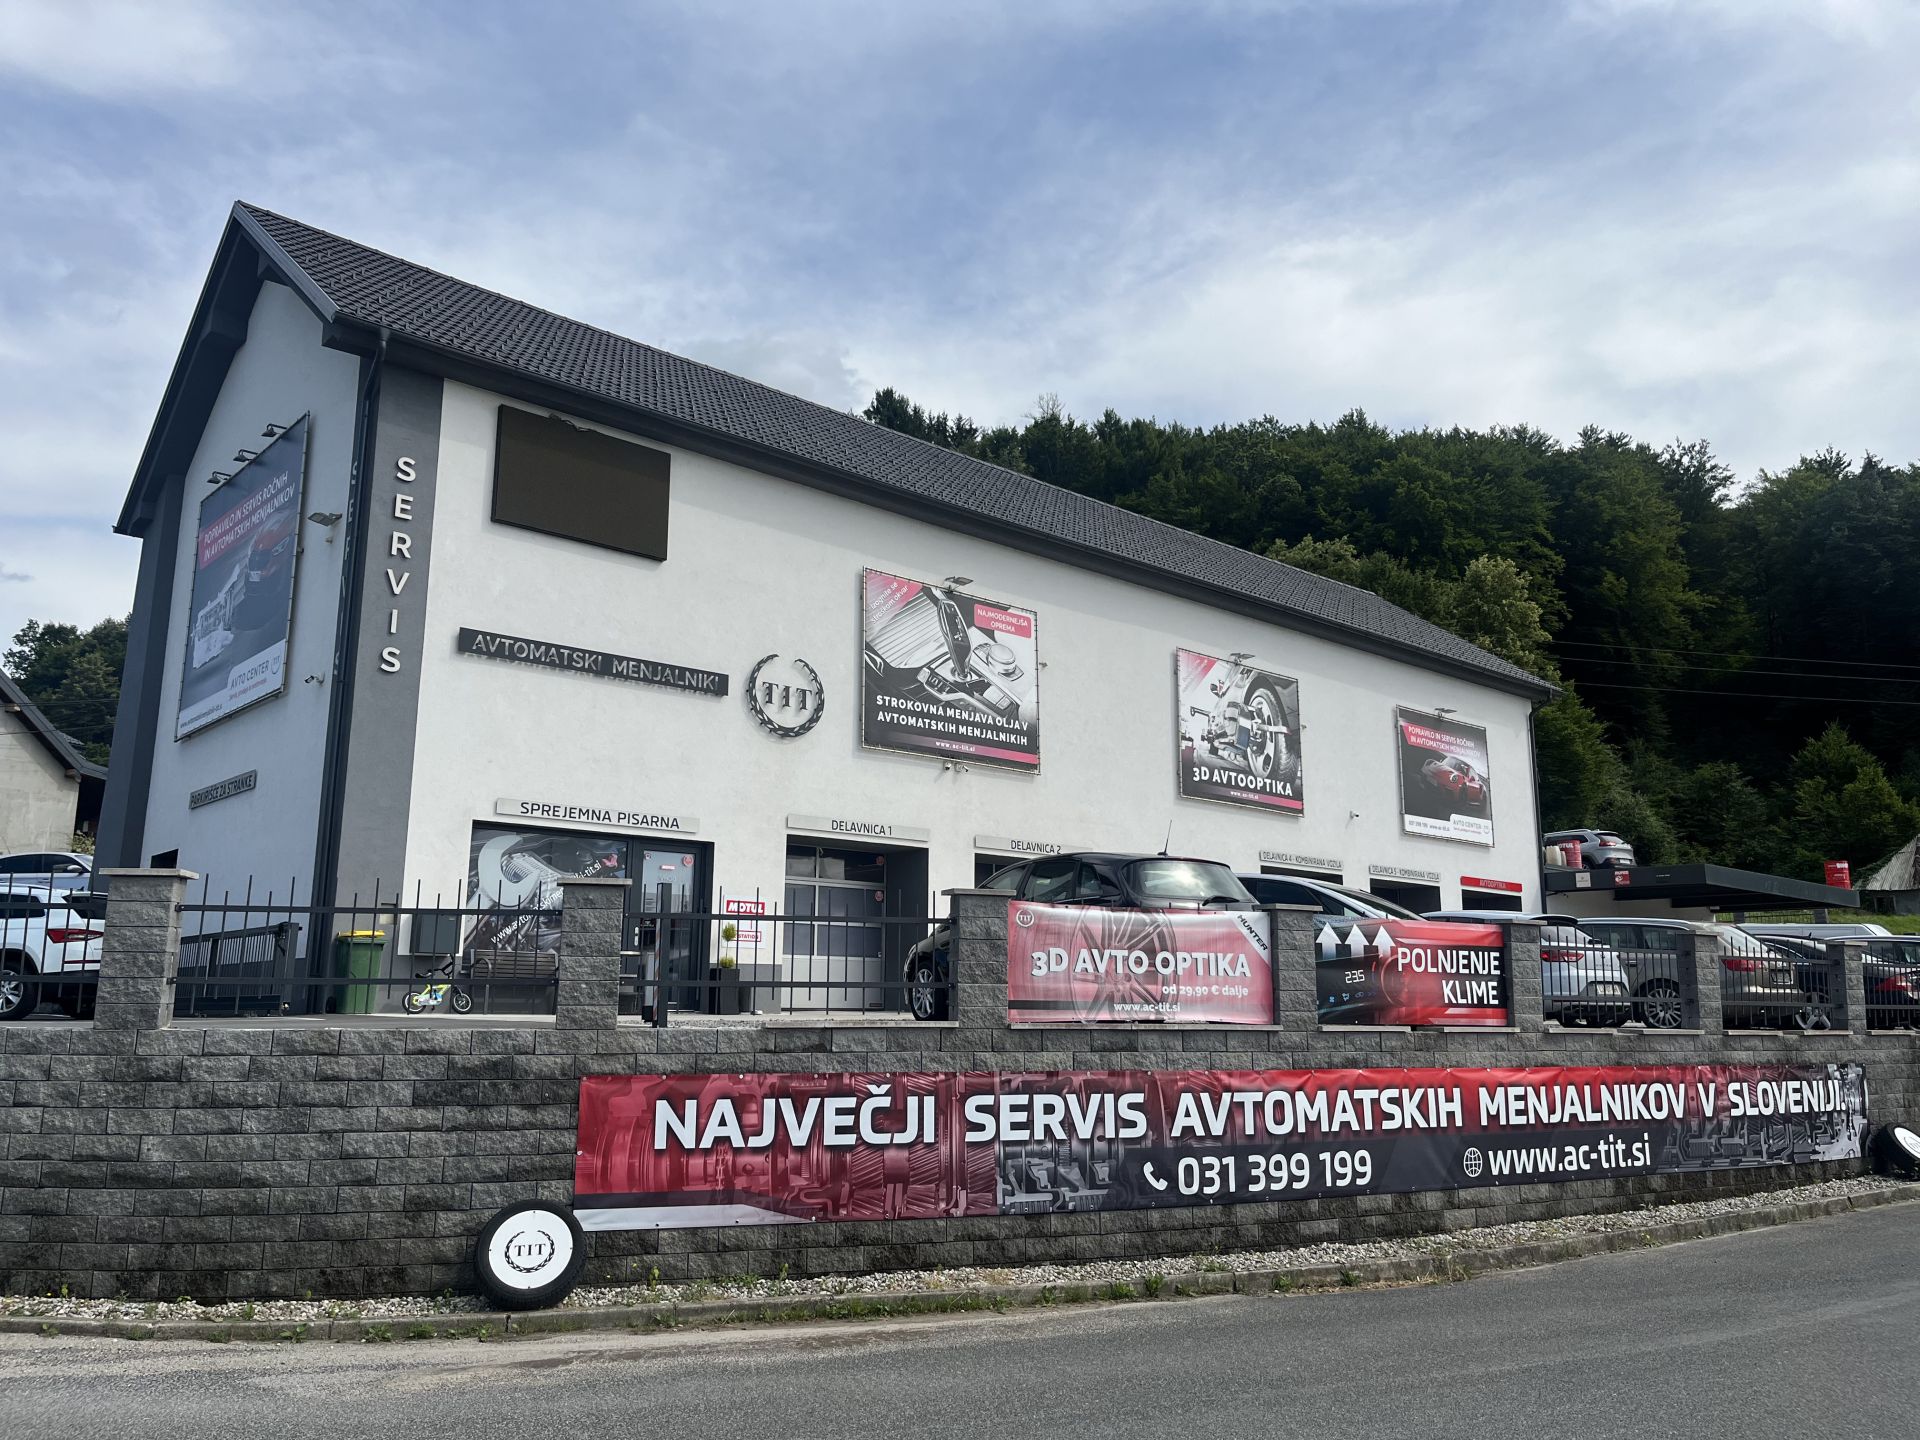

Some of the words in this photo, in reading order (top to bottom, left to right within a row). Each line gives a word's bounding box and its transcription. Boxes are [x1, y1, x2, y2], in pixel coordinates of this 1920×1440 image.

[203, 549, 210, 561] IN
[210, 519, 251, 556] AVTOMATSKIH
[251, 483, 295, 525] MENJALNIKOV
[204, 514, 235, 546] POPRAVILO
[234, 505, 242, 521] IN
[241, 492, 262, 518] SERVIS
[263, 471, 288, 500] ROČNIH
[381, 456, 416, 673] SERVIS
[977, 609, 1028, 627] NAJMODERNEJŠA
[990, 621, 1015, 633] OPREMA
[230, 672, 246, 690] AVTO
[247, 660, 269, 681] CENTER
[472, 634, 602, 671] AVTOMATSKI
[612, 657, 719, 690] MENJALNIKI
[762, 681, 813, 711] TIT
[876, 694, 944, 717] STROKOVNA
[946, 707, 993, 726] MENJAVA
[996, 717, 1022, 730] OLJA
[1022, 722, 1028, 731] V
[877, 711, 956, 734] AVTOMATSKIH
[959, 724, 1028, 746] MENJALNIKIH
[1408, 726, 1435, 739] POPRAVILO
[1441, 733, 1457, 744] SERVIS
[1457, 737, 1475, 748] ROČNIH
[1416, 736, 1449, 750] AVTOMATSKIH
[191, 785, 219, 808] PARKIRIŠČE
[227, 774, 252, 795] STRANKE
[1192, 766, 1210, 782] 3D
[1212, 768, 1293, 797] AVTOOPTIKA
[520, 801, 612, 823] SPREJEMNA
[617, 812, 680, 829] PISARNA
[831, 819, 886, 836] DELAVNICA
[888, 825, 893, 836] 1
[1010, 840, 1055, 854] DELAVNICA
[1056, 846, 1061, 854] 2
[1263, 851, 1288, 862] DELAVNICA
[1372, 865, 1394, 875] DELAVNICA
[728, 902, 764, 914] MOTUL
[1018, 914, 1032, 923] TIT
[1237, 913, 1268, 951] HUNTER
[1031, 947, 1069, 977] 3D
[1074, 949, 1149, 975] AVTO
[1155, 951, 1252, 978] OPTIKA
[1397, 947, 1500, 975] POLNJENJE
[1162, 985, 1177, 995] od
[1211, 985, 1220, 995] €
[1222, 984, 1249, 997] dalje
[1442, 980, 1499, 1005] KLIME
[1114, 1002, 1181, 1013] www.ac-tit.si
[654, 1084, 935, 1150] NAJVEČJI
[964, 1092, 1147, 1143] SERVIS
[1171, 1087, 1463, 1137] AVTOMATSKIH
[1478, 1082, 1685, 1127] MENJALNIKOV
[1697, 1082, 1716, 1118] V
[1727, 1079, 1846, 1117] SLOVENIJI.
[1488, 1132, 1651, 1176] www.ac-tit.si
[1177, 1156, 1236, 1195] 031
[1249, 1152, 1310, 1192] 399
[1319, 1149, 1372, 1187] 199
[514, 1243, 546, 1257] TIT
